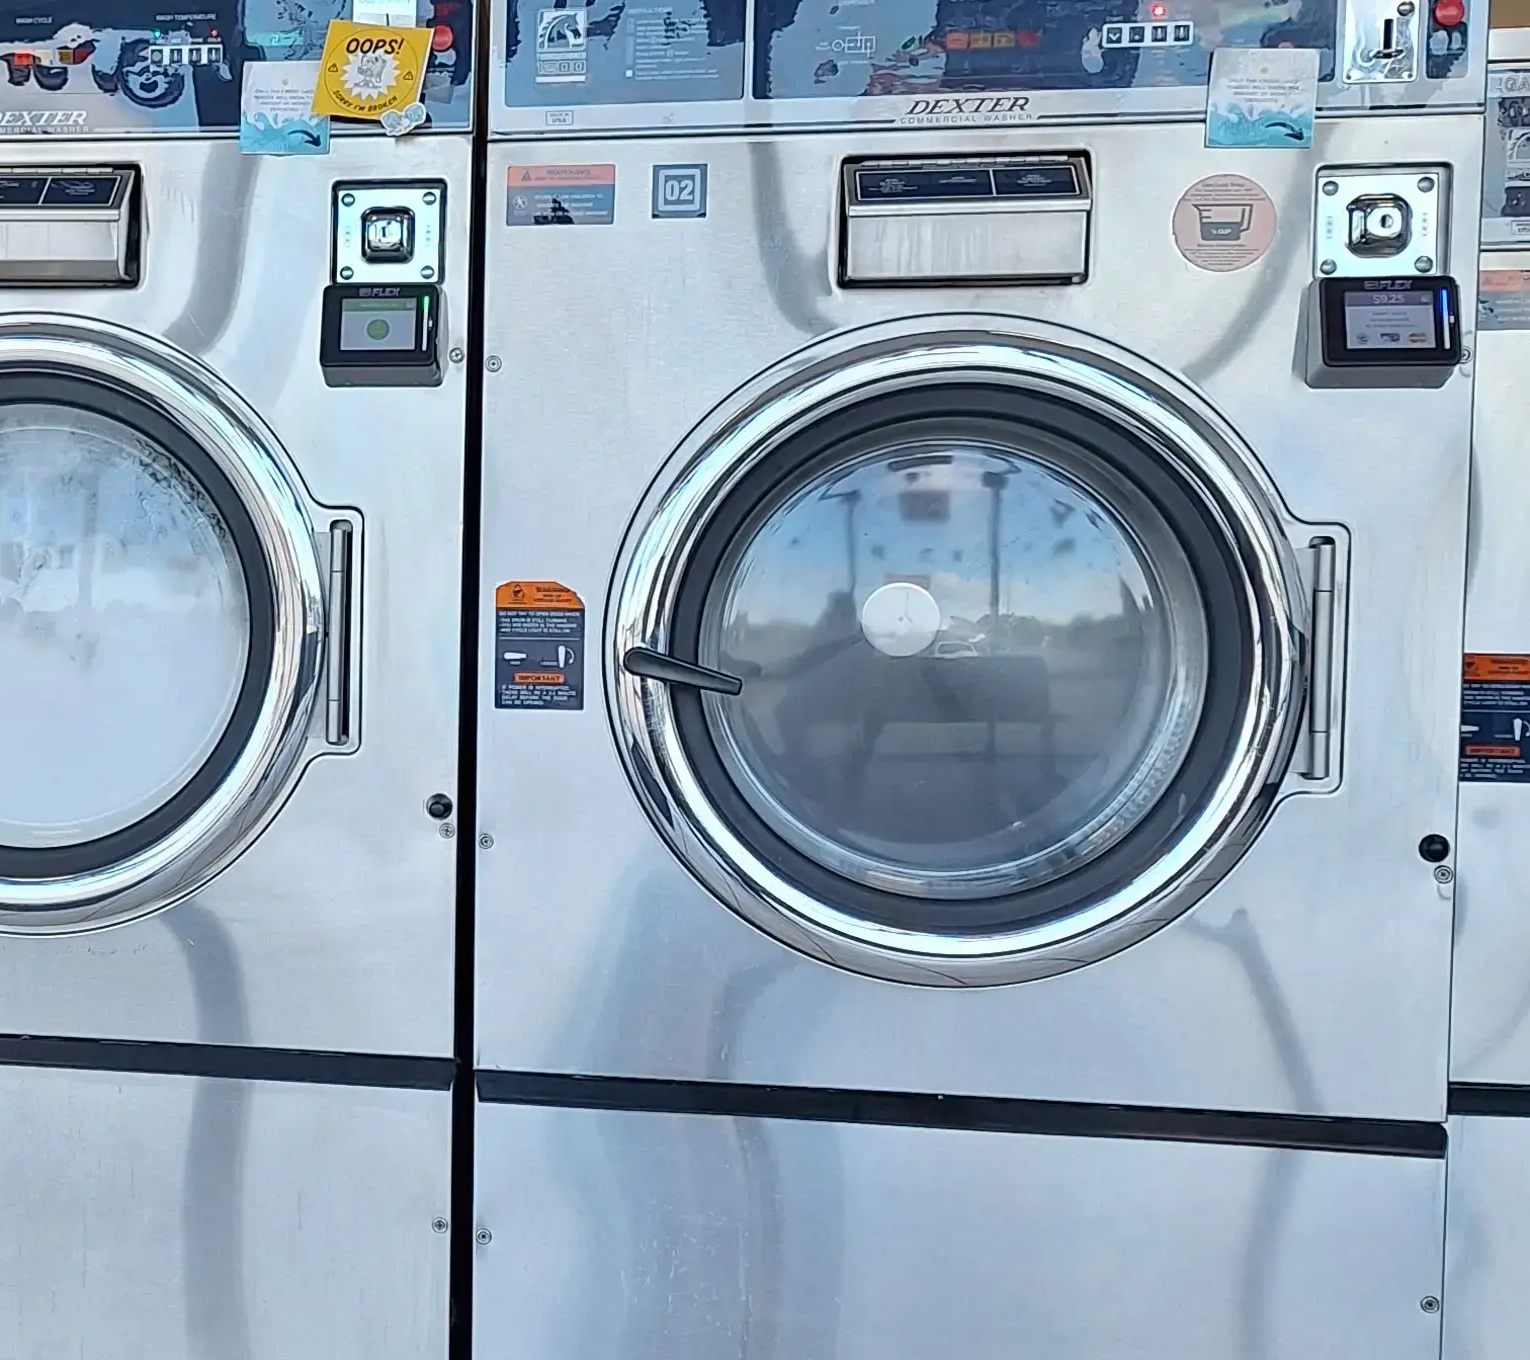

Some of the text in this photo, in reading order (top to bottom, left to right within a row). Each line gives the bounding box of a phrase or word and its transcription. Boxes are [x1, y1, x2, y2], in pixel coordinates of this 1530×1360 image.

[345, 37, 405, 55] OOPS!
[332, 89, 353, 107] SORRY
[367, 95, 398, 112] BROKEN
[905, 96, 1030, 115] DEXTER
[900, 113, 1033, 125] COMMERCIAL WASHER
[47, 125, 89, 134] WASHER
[665, 179, 694, 201] 02
[371, 287, 401, 297] FLEX
